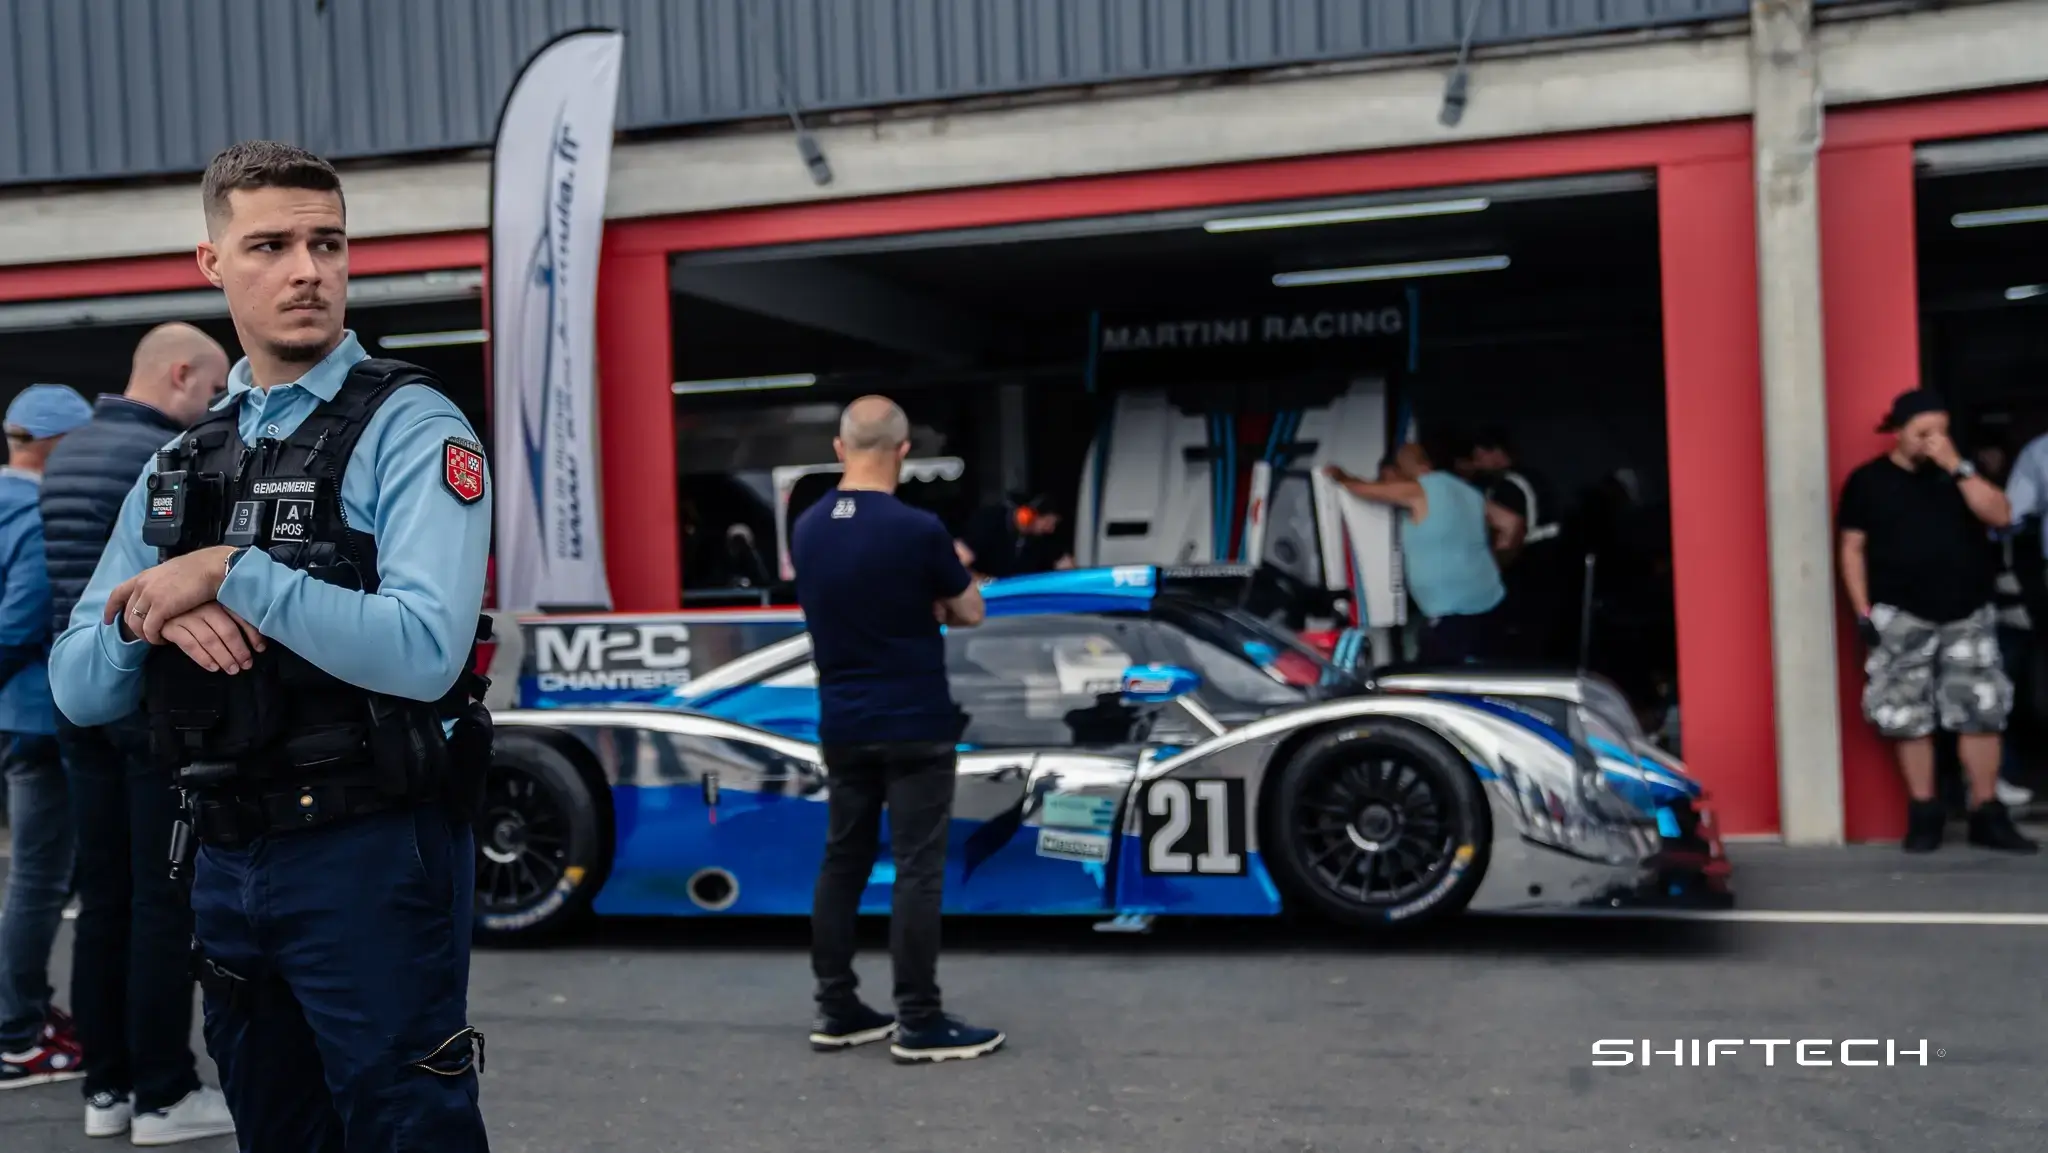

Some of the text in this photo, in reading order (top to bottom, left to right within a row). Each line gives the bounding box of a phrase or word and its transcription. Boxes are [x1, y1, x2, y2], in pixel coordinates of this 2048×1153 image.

[1103, 308, 1403, 349] MARTINI RACING
[253, 481, 316, 494] GENDARMERIE
[286, 504, 300, 520] A
[1147, 780, 1241, 873] 21
